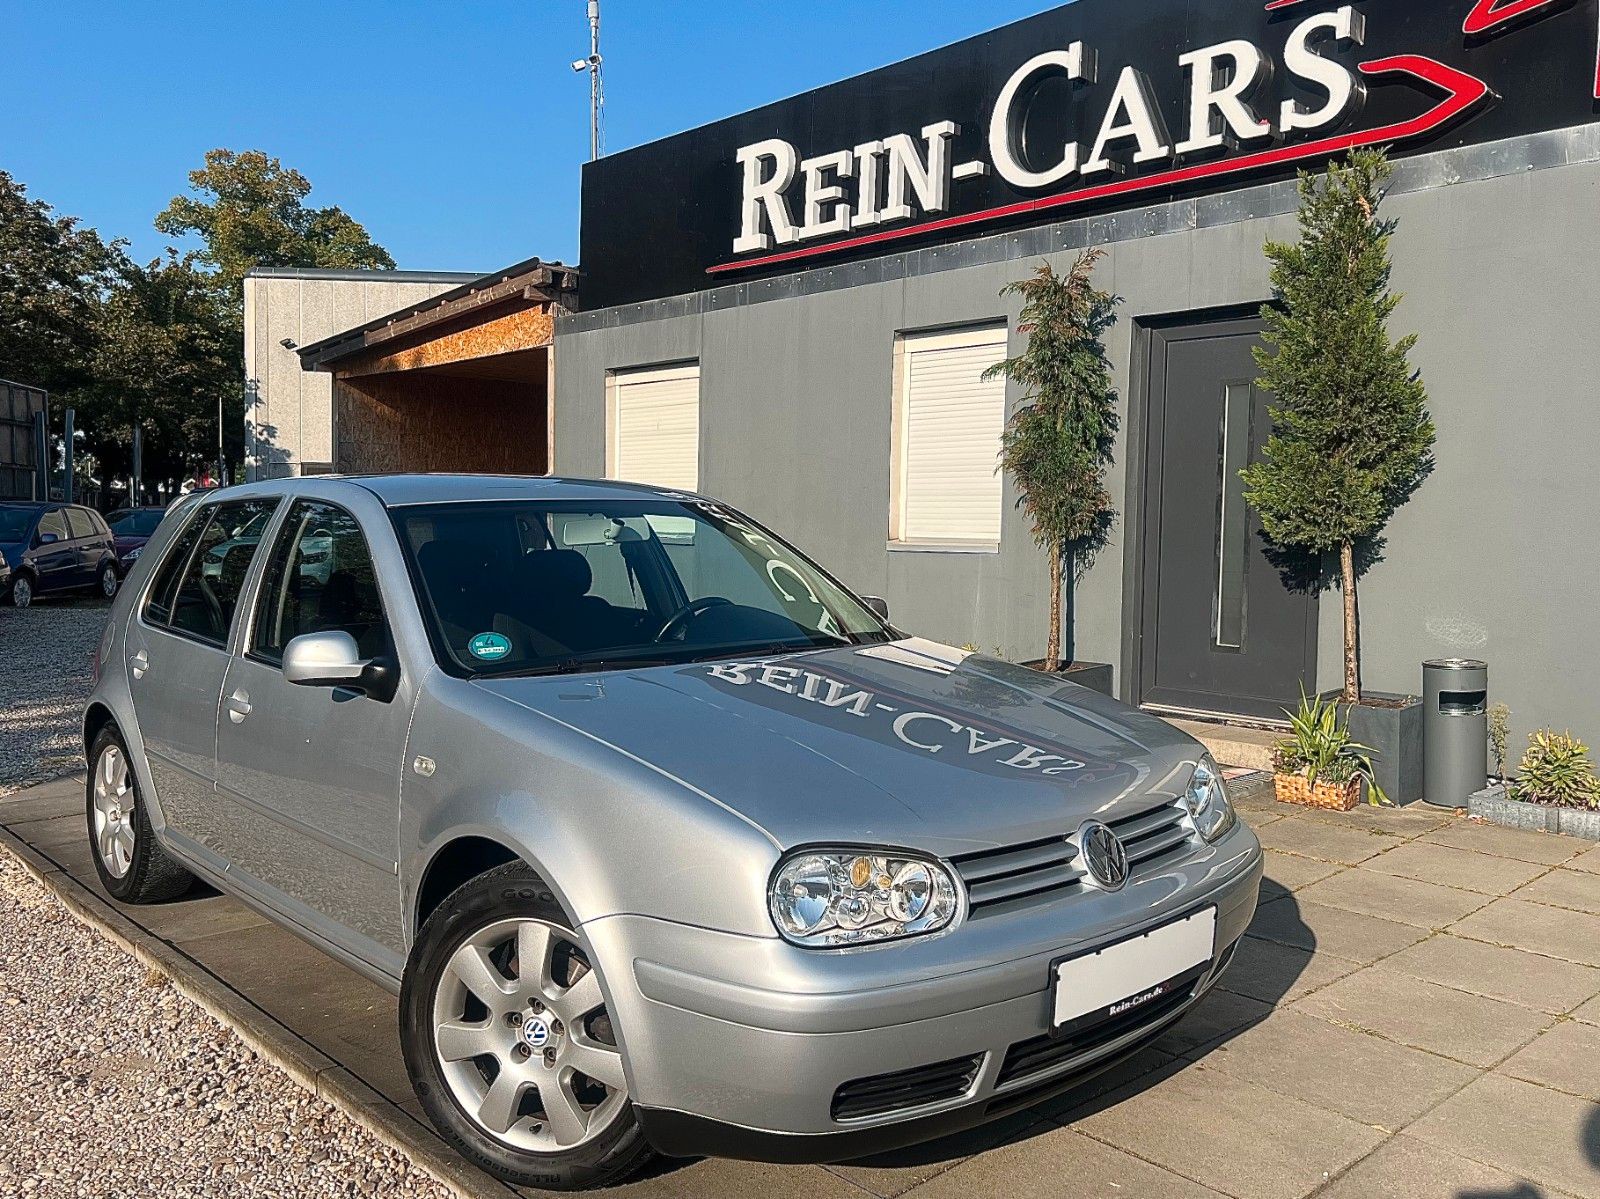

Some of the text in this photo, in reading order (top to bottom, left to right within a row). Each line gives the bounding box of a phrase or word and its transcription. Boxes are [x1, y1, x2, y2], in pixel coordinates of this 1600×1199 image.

[485, 634, 495, 646] 4
[502, 888, 557, 902] GOO
[1108, 986, 1164, 1016] Rein-Cars.de
